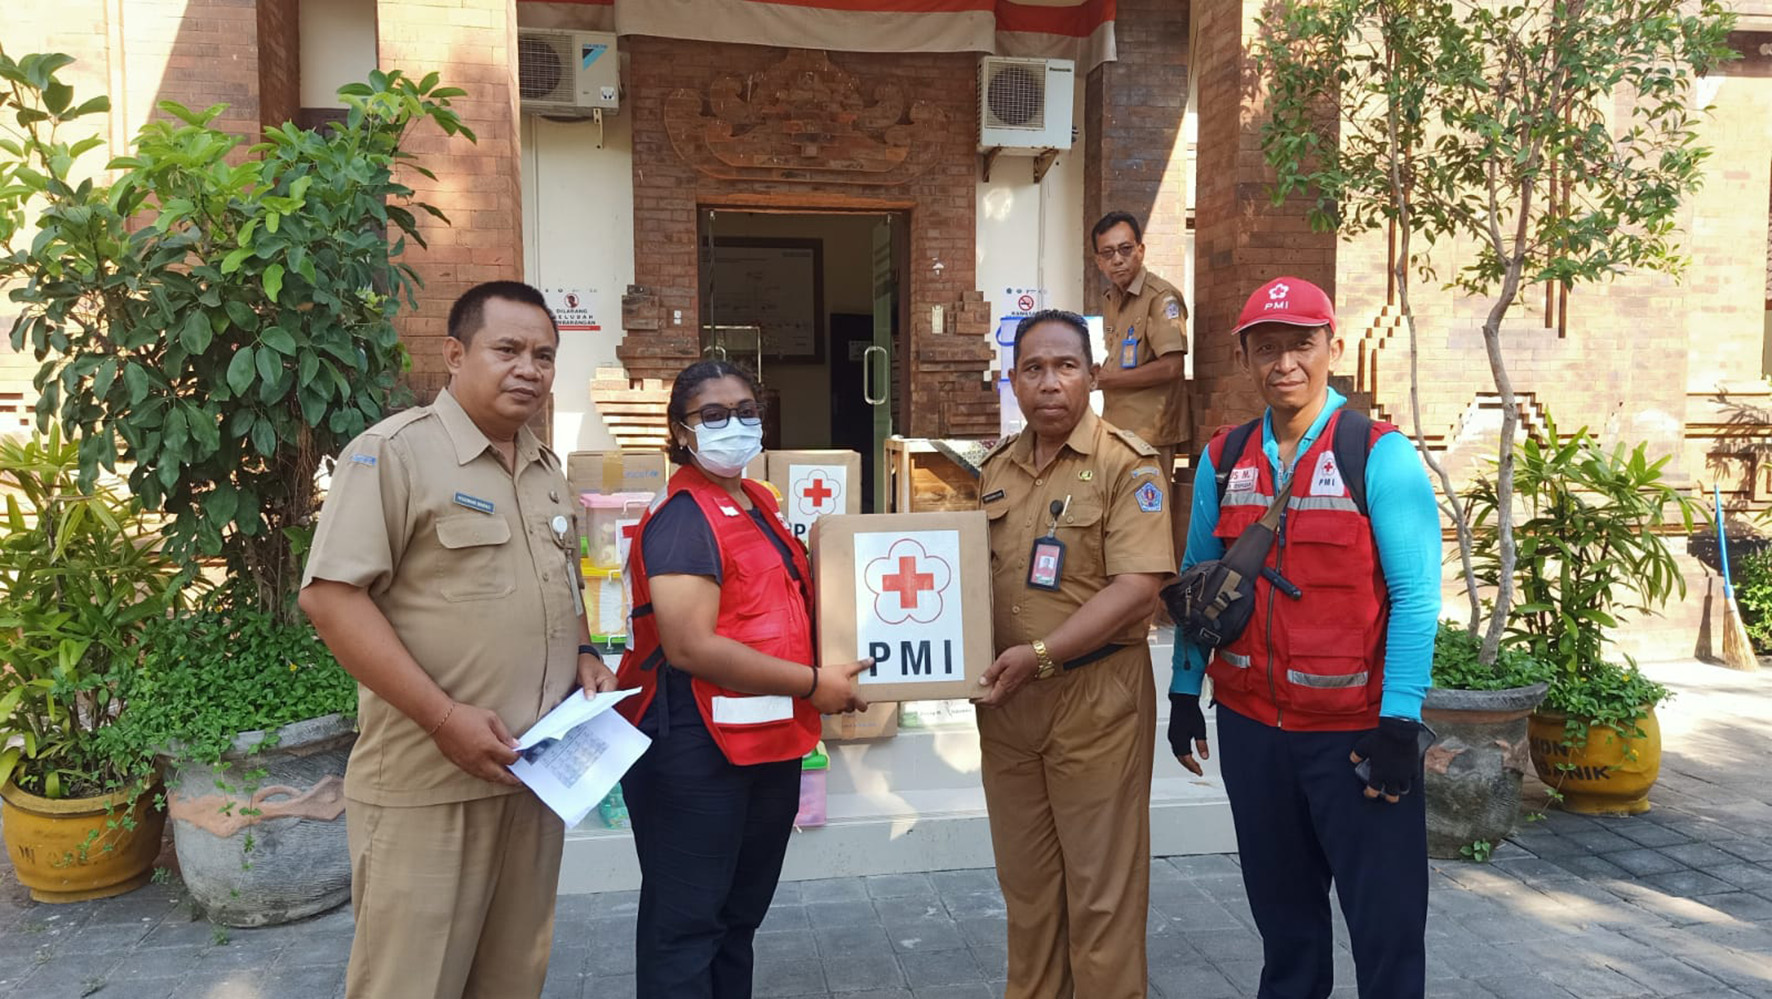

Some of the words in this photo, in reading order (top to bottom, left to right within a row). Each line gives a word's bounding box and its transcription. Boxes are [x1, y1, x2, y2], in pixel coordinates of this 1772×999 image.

[1264, 301, 1289, 311] PMI
[1318, 478, 1335, 487] PMI
[869, 639, 952, 678] PMI
